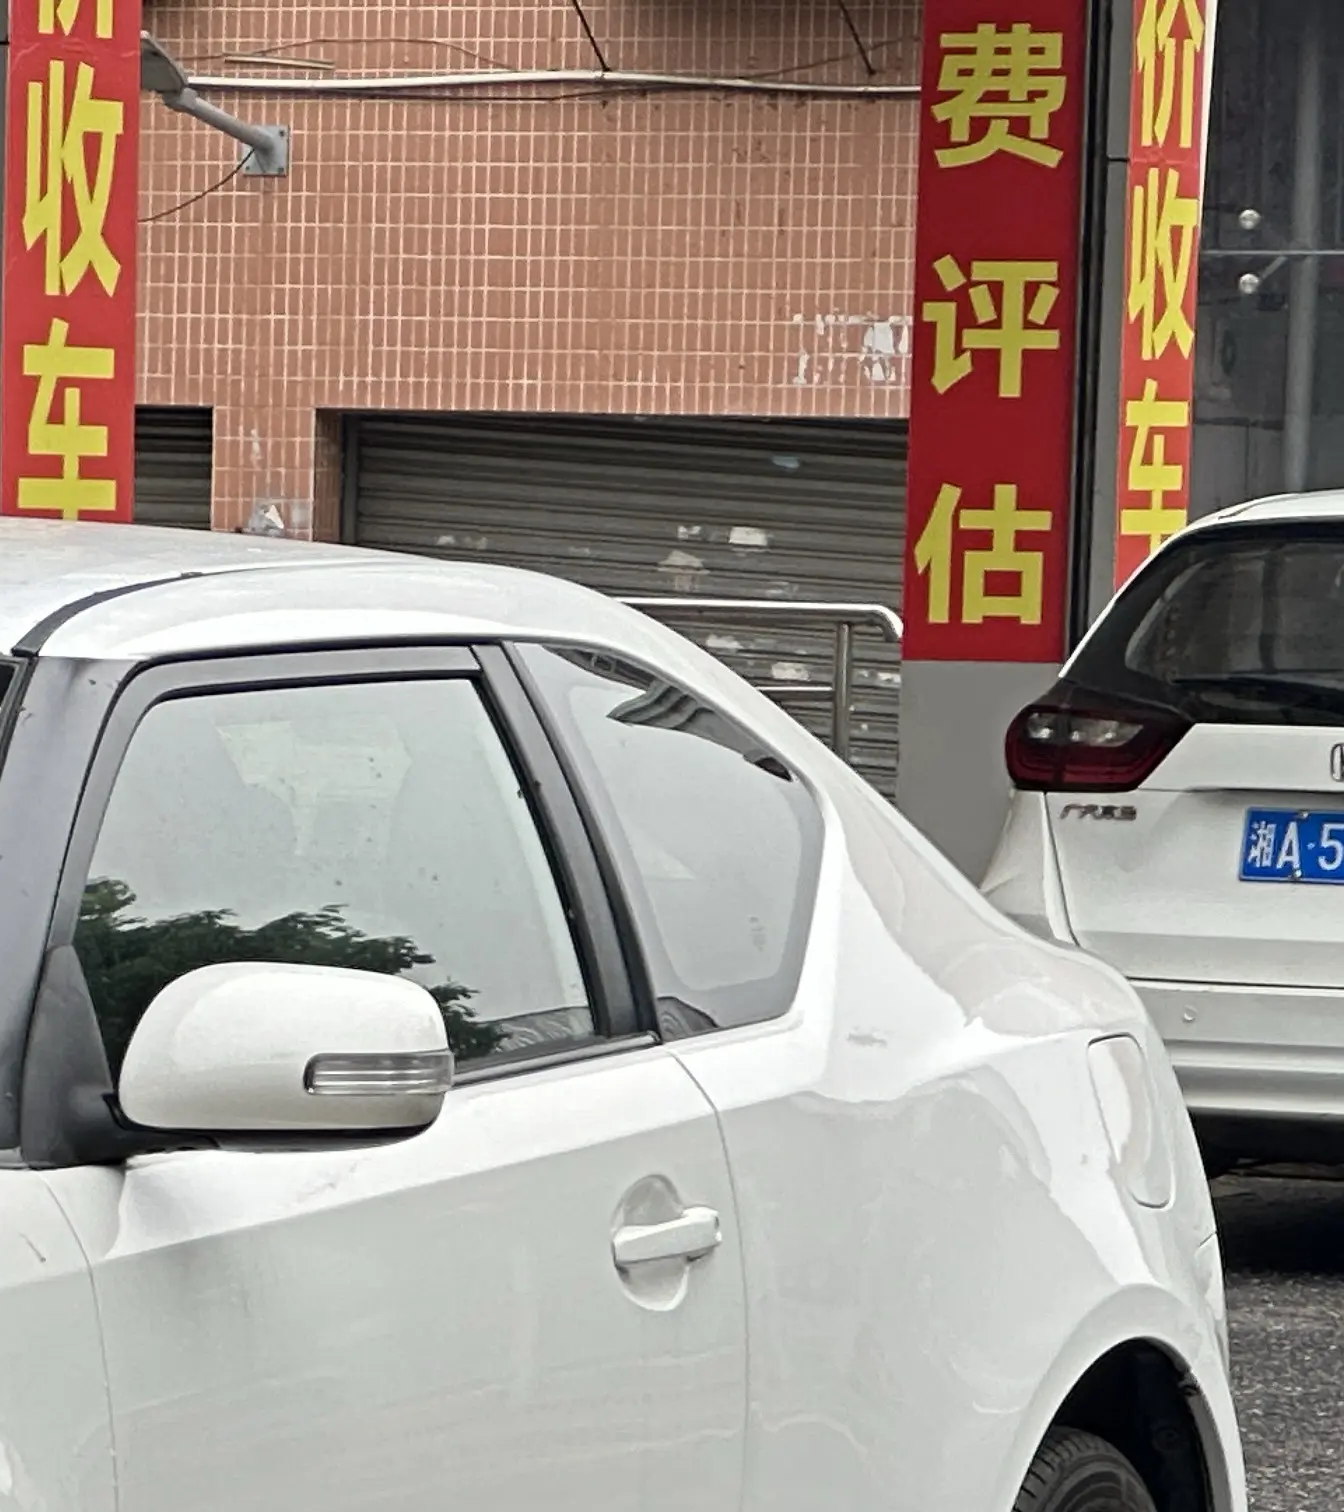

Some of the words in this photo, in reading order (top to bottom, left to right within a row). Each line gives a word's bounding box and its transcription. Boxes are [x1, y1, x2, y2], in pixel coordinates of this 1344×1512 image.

[17, 0, 124, 520] 收车
[914, 23, 1068, 625] 费评估
